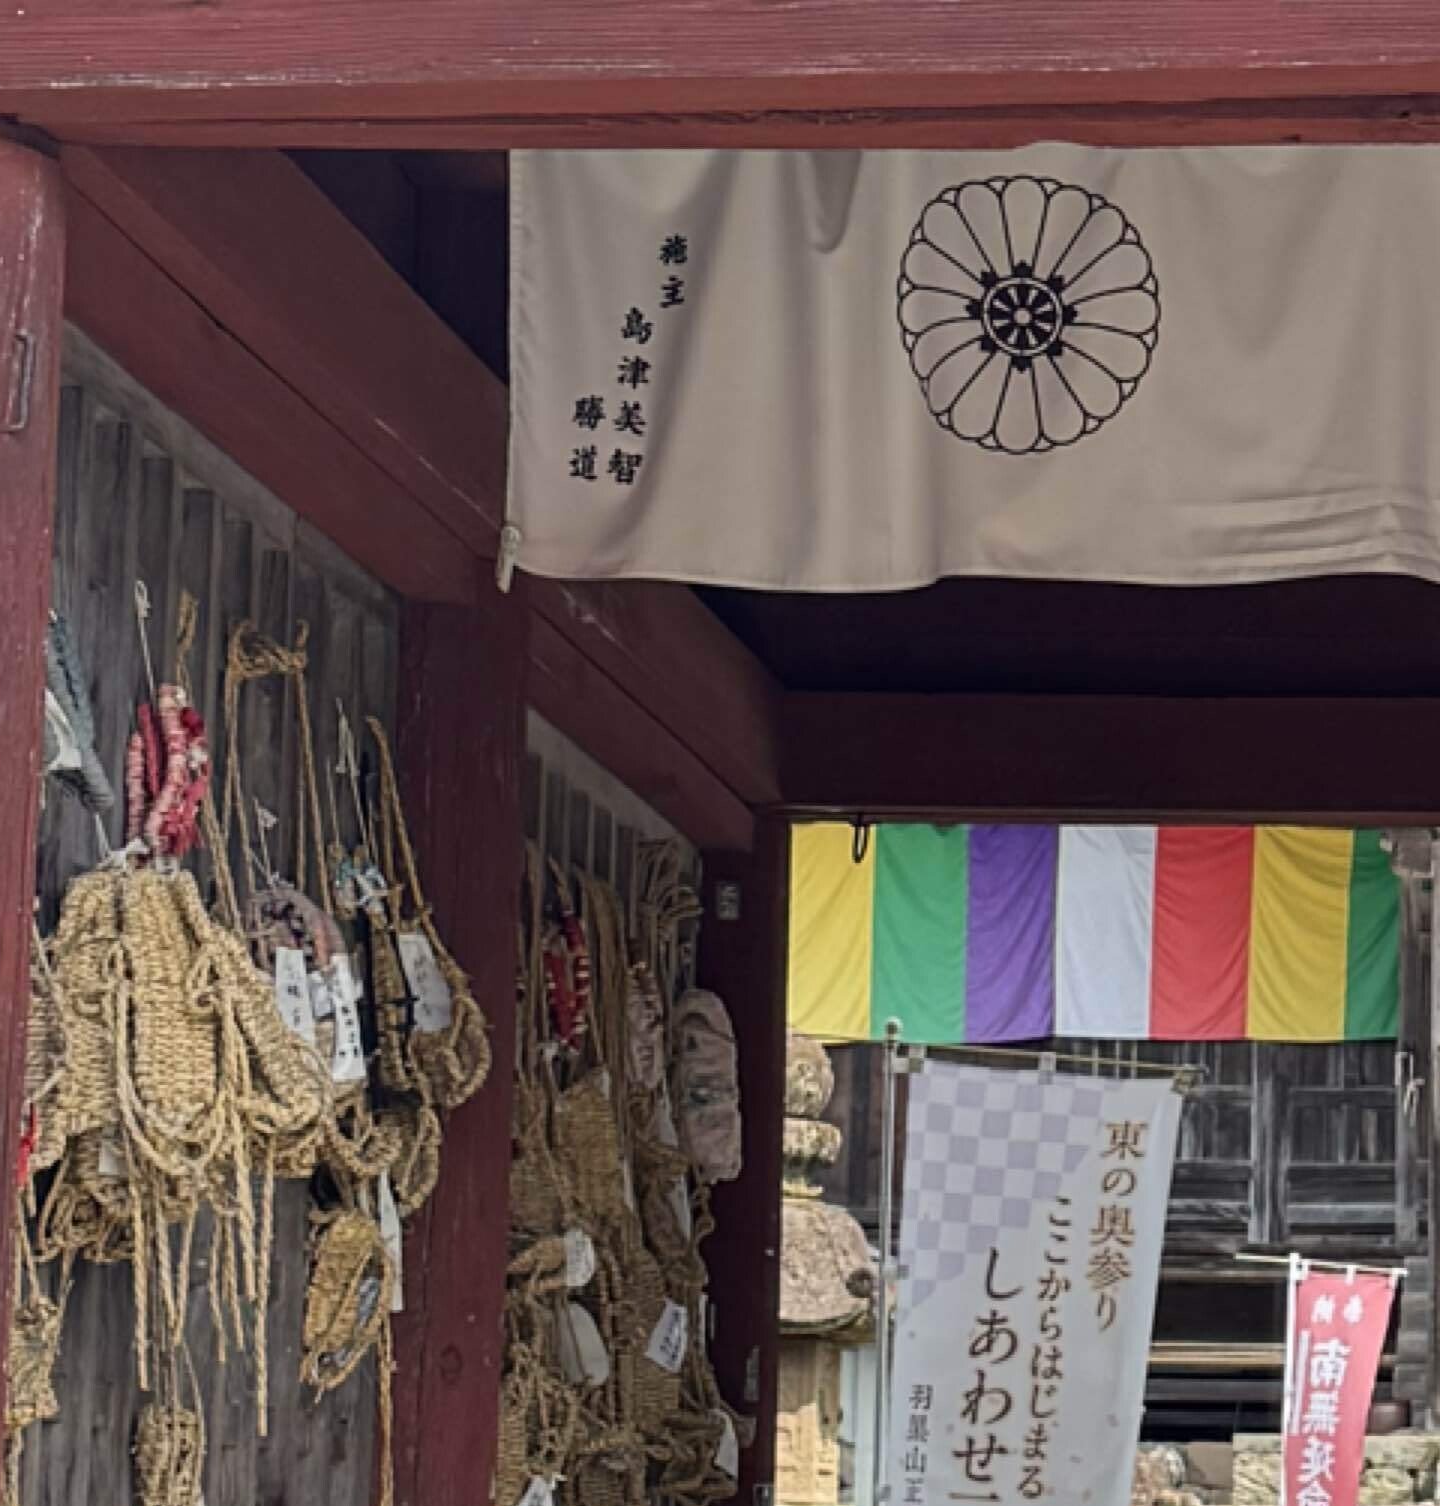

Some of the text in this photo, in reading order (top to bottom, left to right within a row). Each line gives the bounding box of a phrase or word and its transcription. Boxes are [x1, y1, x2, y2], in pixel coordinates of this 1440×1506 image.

[1016, 1196, 1073, 1499] ここからはじまる
[1085, 1120, 1149, 1332] 東の奥参り
